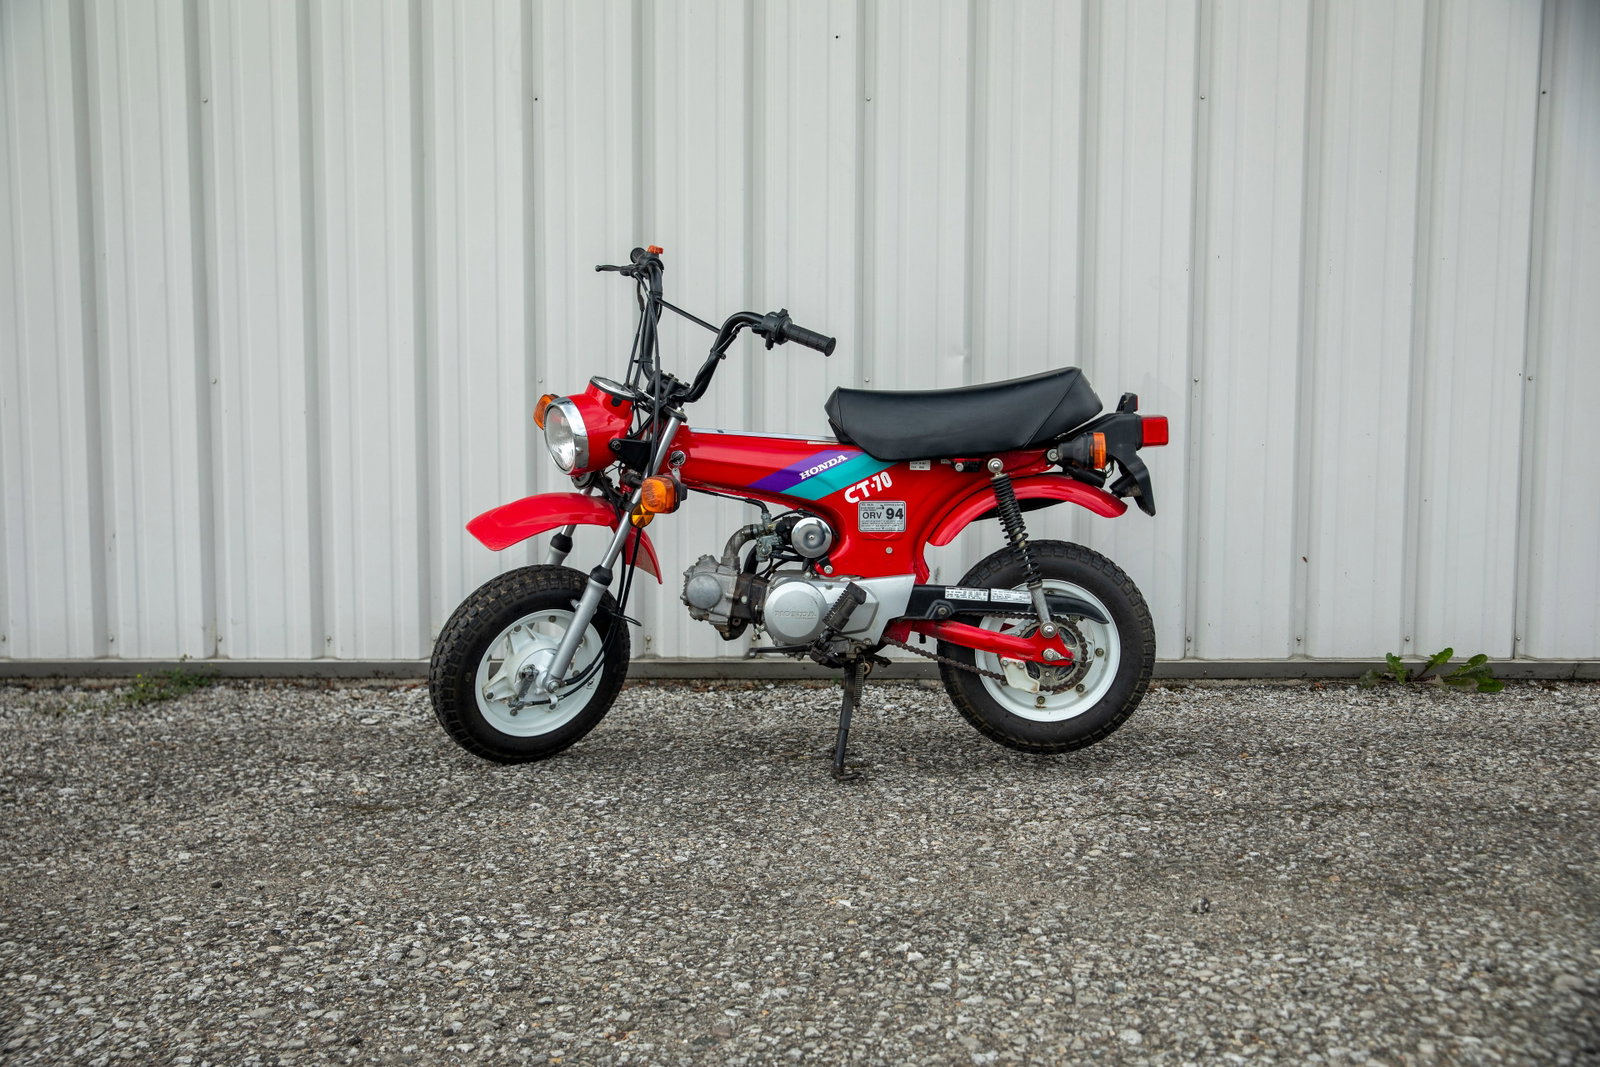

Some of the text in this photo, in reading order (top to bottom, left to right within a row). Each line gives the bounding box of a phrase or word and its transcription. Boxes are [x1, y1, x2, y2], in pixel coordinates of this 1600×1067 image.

[799, 454, 848, 480] HONDA
[862, 511, 882, 519] ORV
[886, 507, 904, 520] 94
